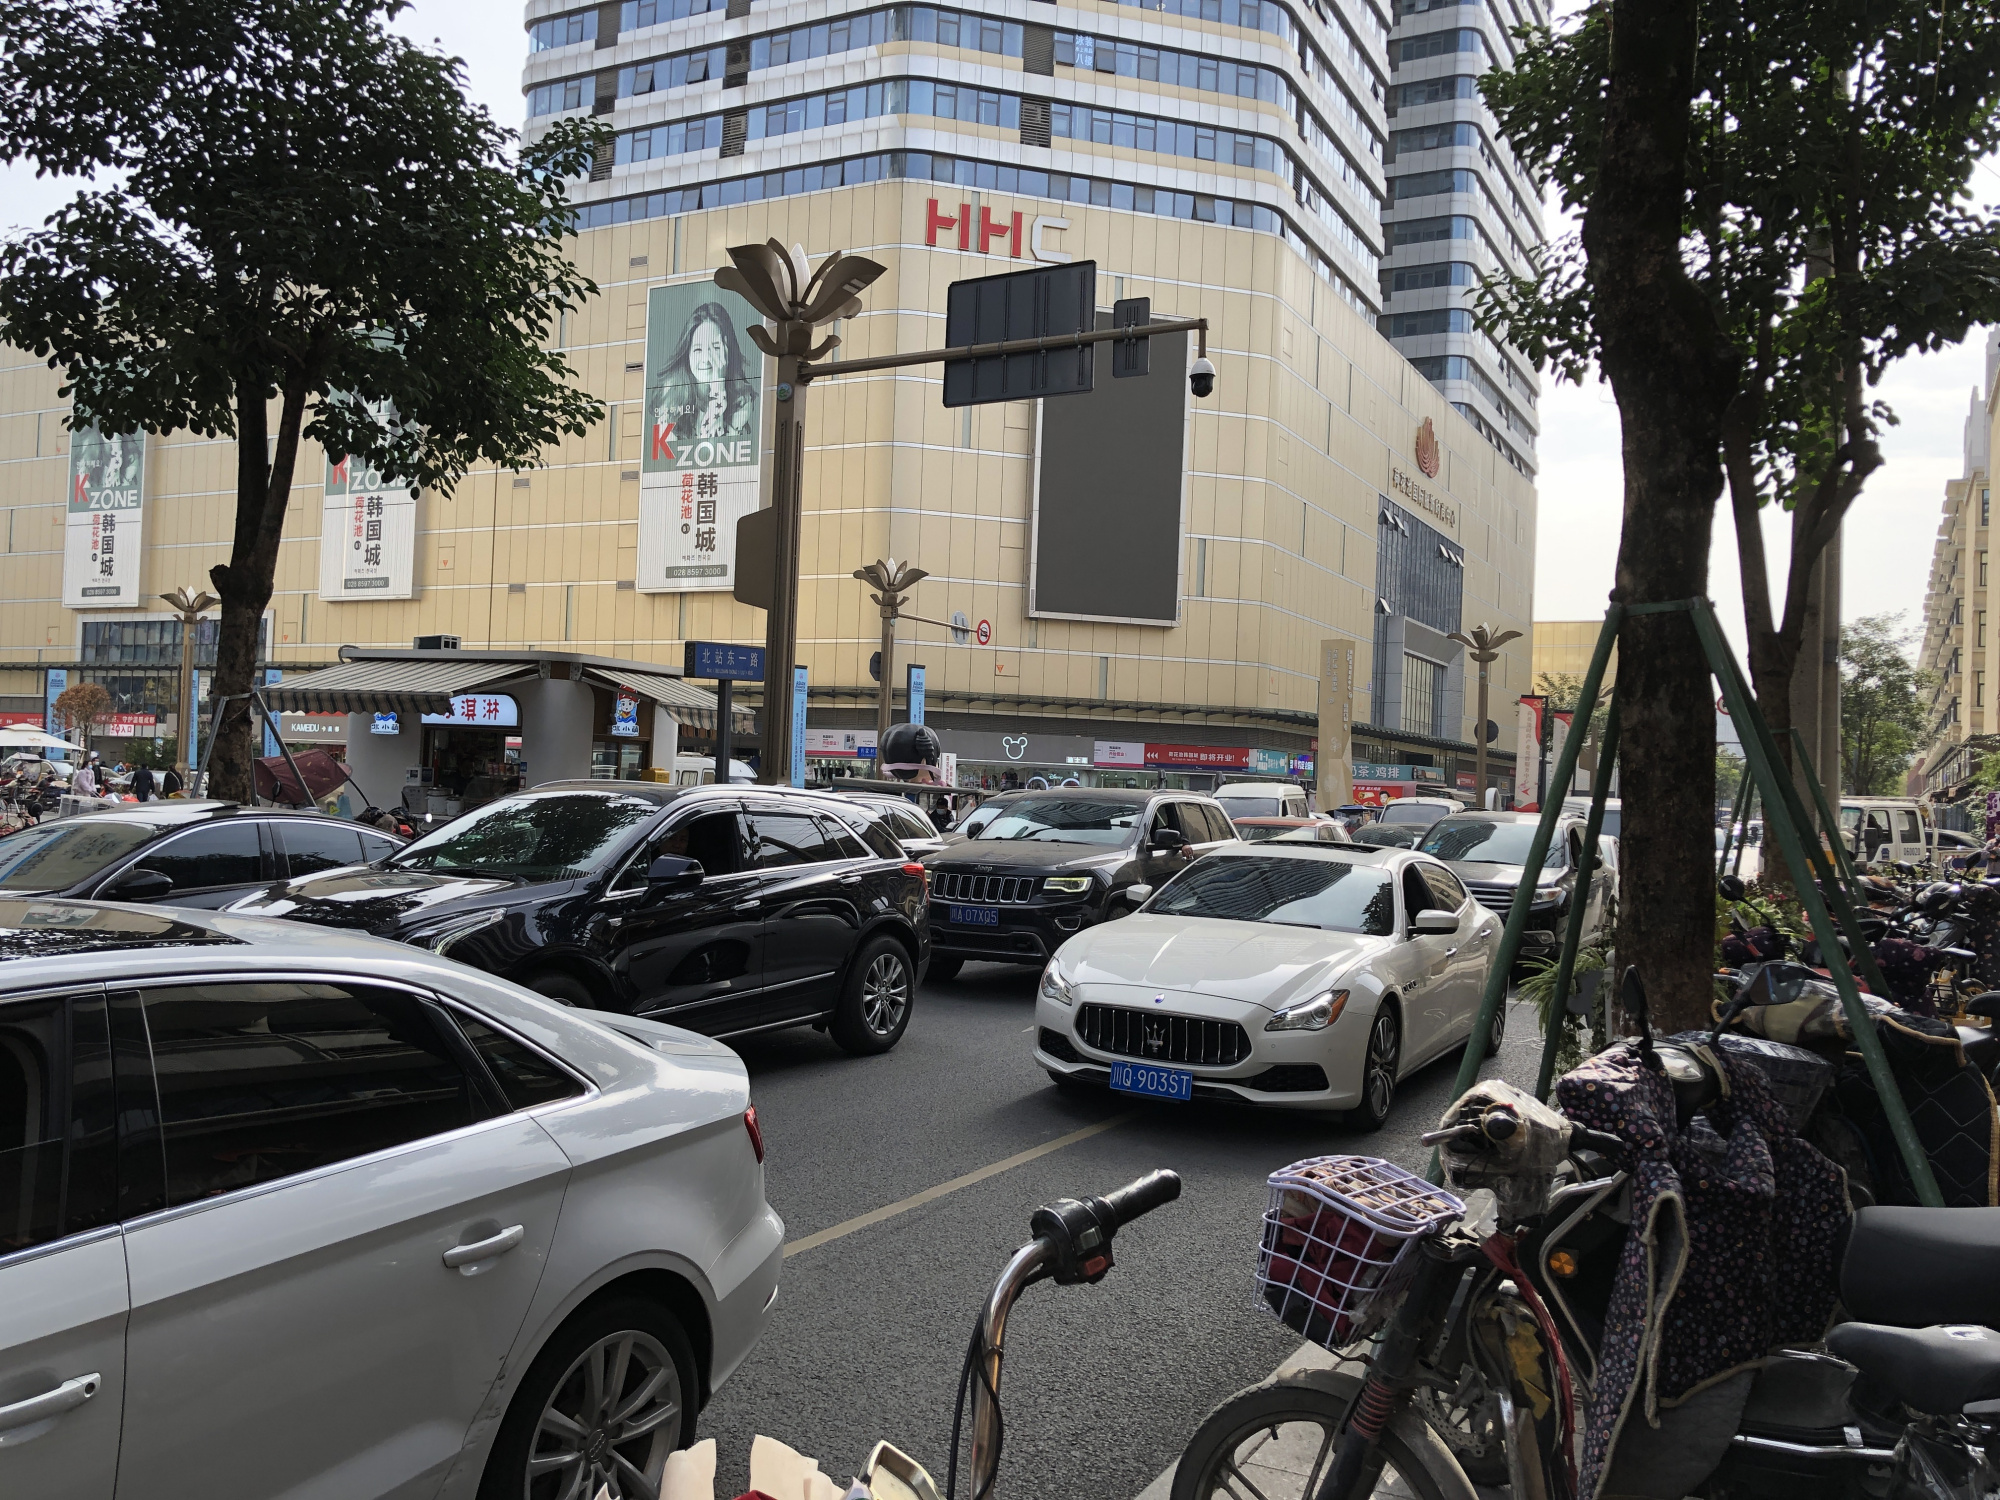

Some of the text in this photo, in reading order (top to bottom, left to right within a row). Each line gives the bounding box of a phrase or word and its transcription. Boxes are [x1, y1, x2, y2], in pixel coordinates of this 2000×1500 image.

[652, 422, 751, 467] K ZONE
[74, 473, 137, 510] K ZONE
[680, 473, 694, 520] 荷花池
[695, 472, 718, 552] 韩国城
[91, 513, 101, 551] 荷花池
[353, 496, 365, 537] 荷花池
[364, 495, 383, 566] 韩国城
[100, 513, 116, 577] 韩国城
[673, 567, 721, 577] 028 8597 3000
[702, 648, 759, 668] 北站东一路
[1200, 753, 1235, 762] 即将开业!
